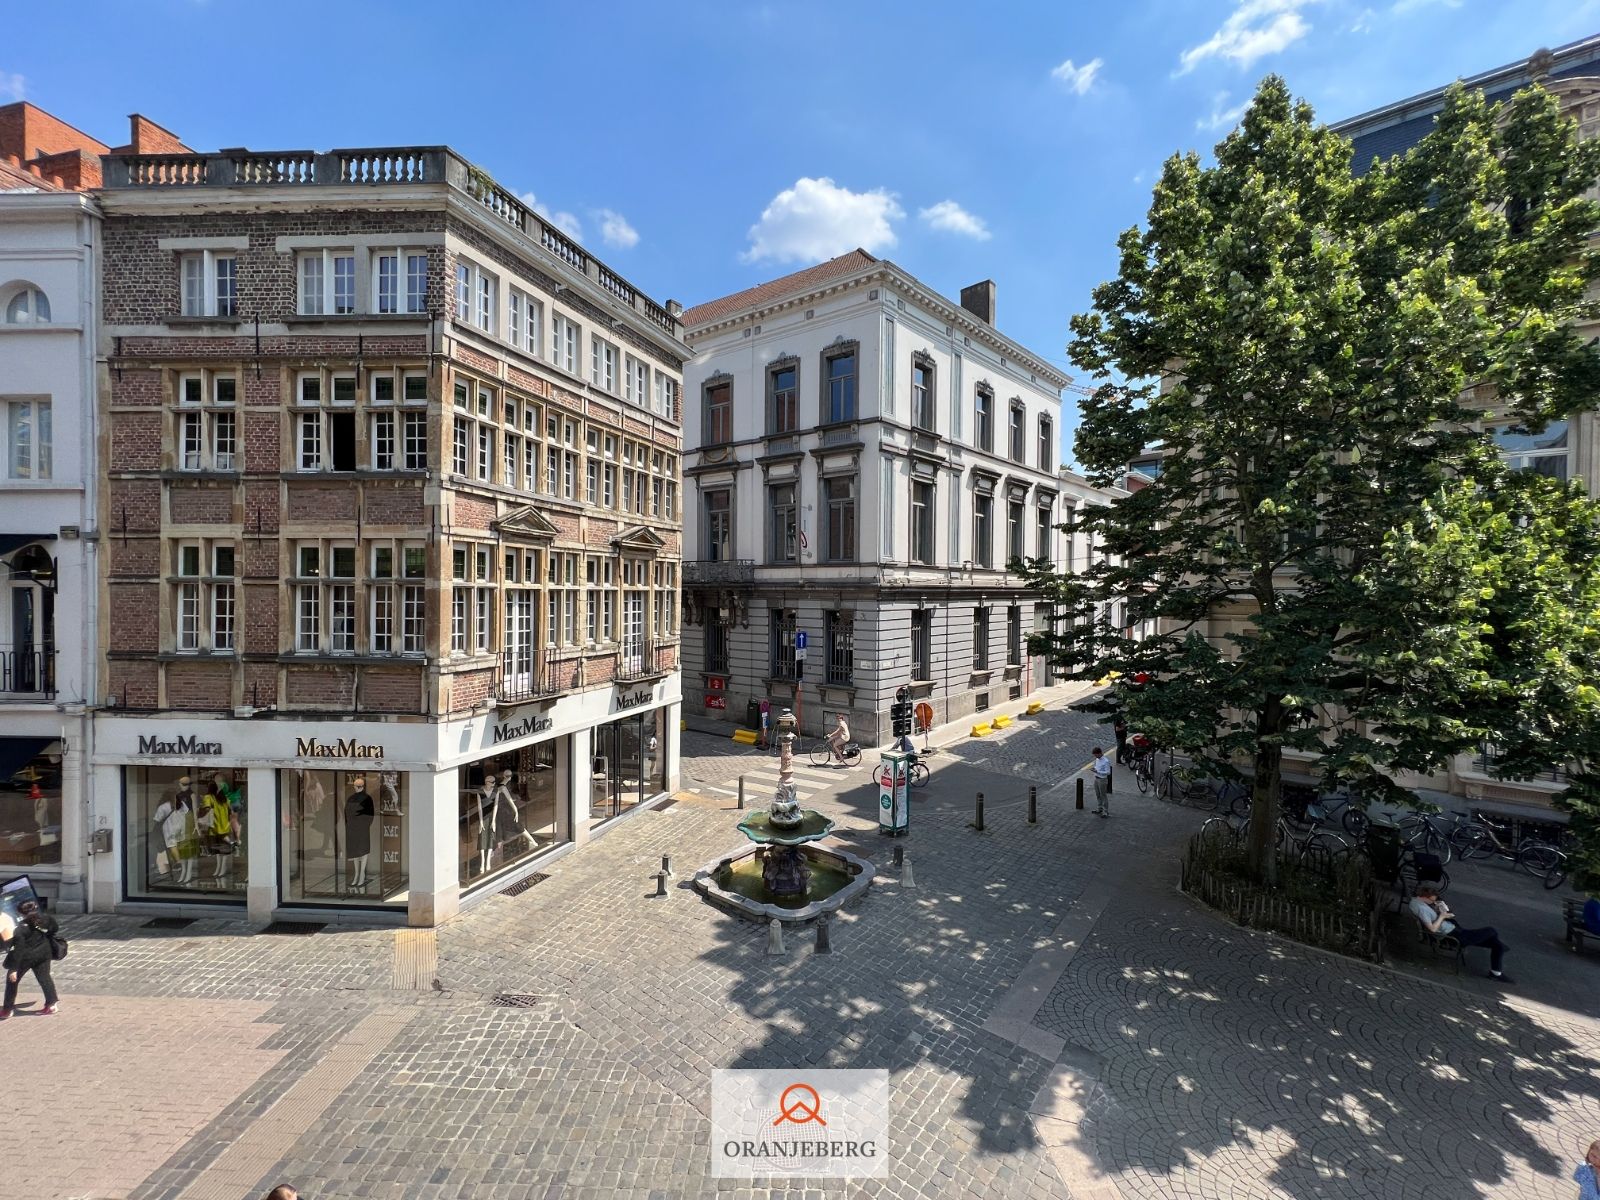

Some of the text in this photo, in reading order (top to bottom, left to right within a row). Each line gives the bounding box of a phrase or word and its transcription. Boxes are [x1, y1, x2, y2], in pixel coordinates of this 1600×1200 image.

[616, 690, 653, 711] MaxMara
[491, 716, 553, 744] MaxMara
[137, 735, 222, 755] MaxMara
[295, 737, 384, 758] MaxMara
